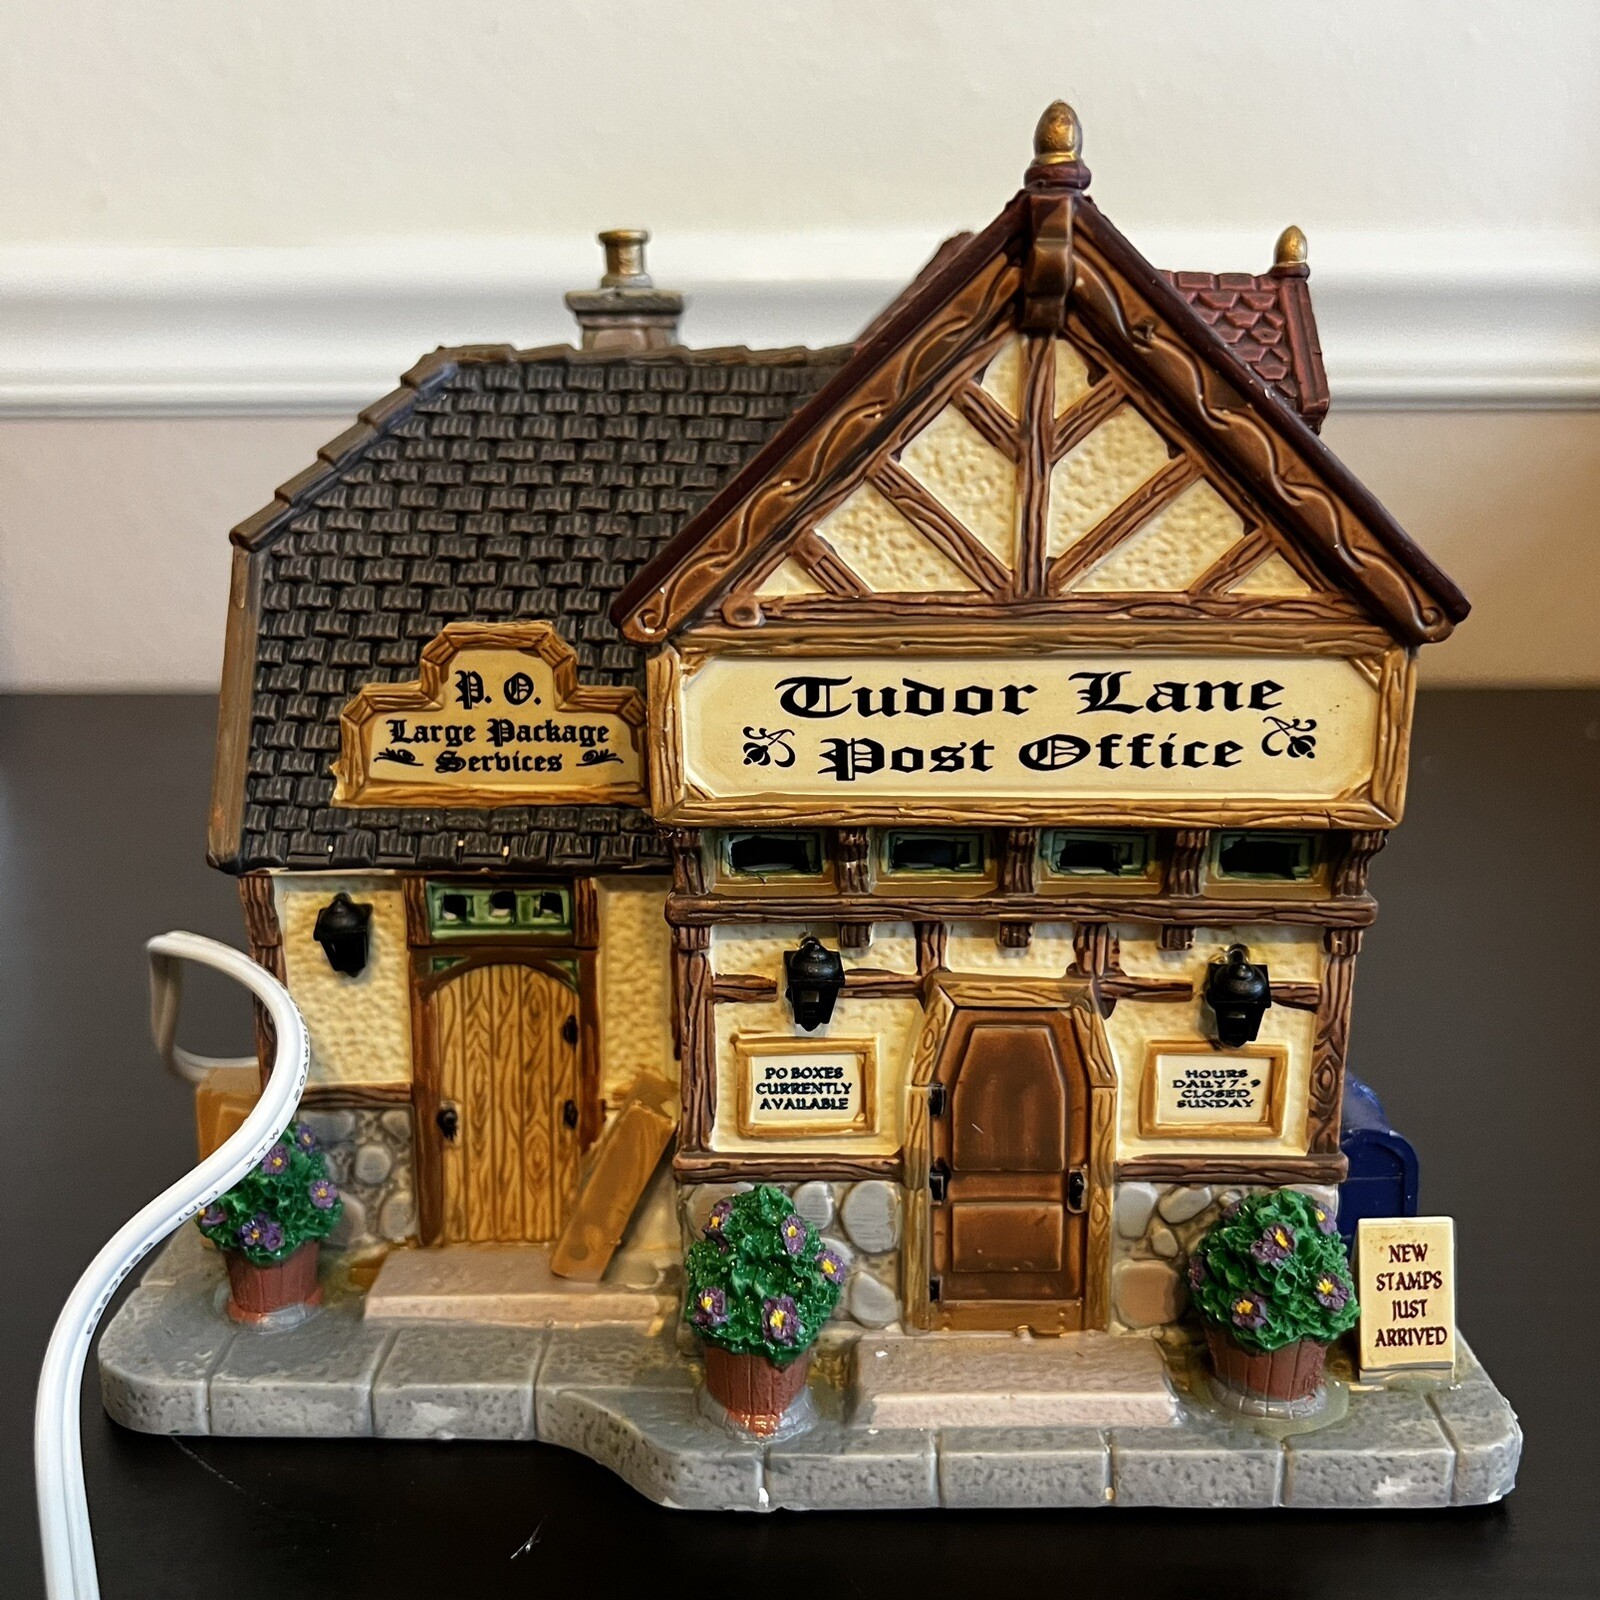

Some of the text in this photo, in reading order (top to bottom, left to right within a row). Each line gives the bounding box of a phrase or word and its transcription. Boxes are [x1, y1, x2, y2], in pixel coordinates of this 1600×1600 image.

[775, 671, 1285, 718] Tudor Lane
[386, 718, 609, 747] Large Package
[435, 750, 562, 773] Services
[818, 733, 1243, 781] Post Office
[765, 1067, 843, 1079] PO BOXES
[1186, 1069, 1248, 1078] HOURS
[756, 1082, 852, 1095] CURRENTLY
[1172, 1079, 1226, 1088] DAILY
[1181, 1089, 1250, 1098] CLOSED
[760, 1098, 848, 1110] AVAILABLE
[1177, 1099, 1254, 1108] SUNDAY
[1389, 1243, 1428, 1263] NEW
[1377, 1271, 1442, 1291] STAMPS
[1392, 1299, 1427, 1321] JUST
[1375, 1326, 1447, 1347] ARRIVED
